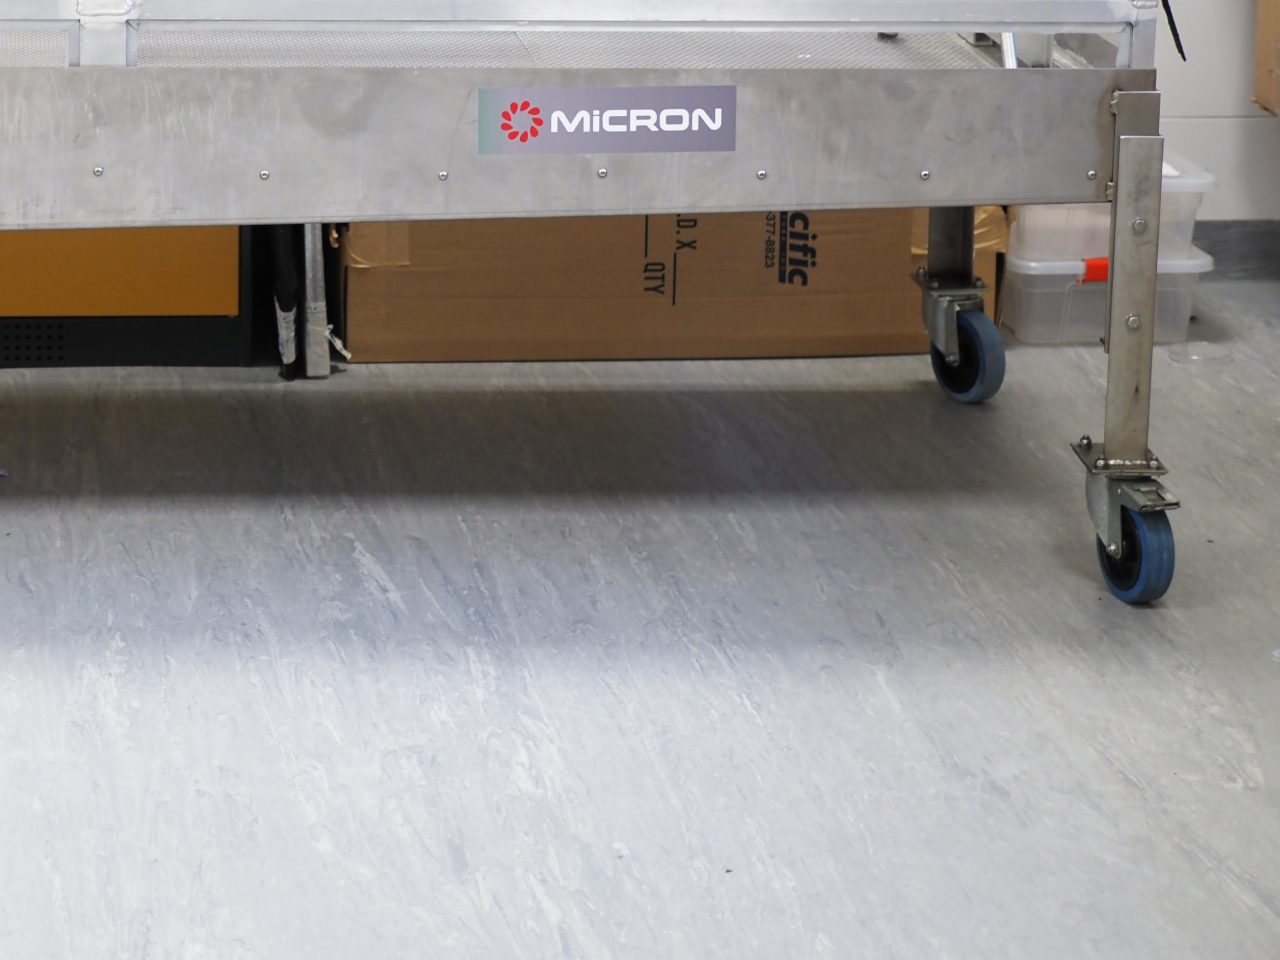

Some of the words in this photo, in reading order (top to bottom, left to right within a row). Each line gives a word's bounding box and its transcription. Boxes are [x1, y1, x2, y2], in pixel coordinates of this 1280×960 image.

[676, 214, 698, 235] .D.
[764, 211, 776, 269] -377-8823
[676, 239, 698, 251] X
[788, 212, 818, 287] cific
[643, 262, 666, 295] QTY
